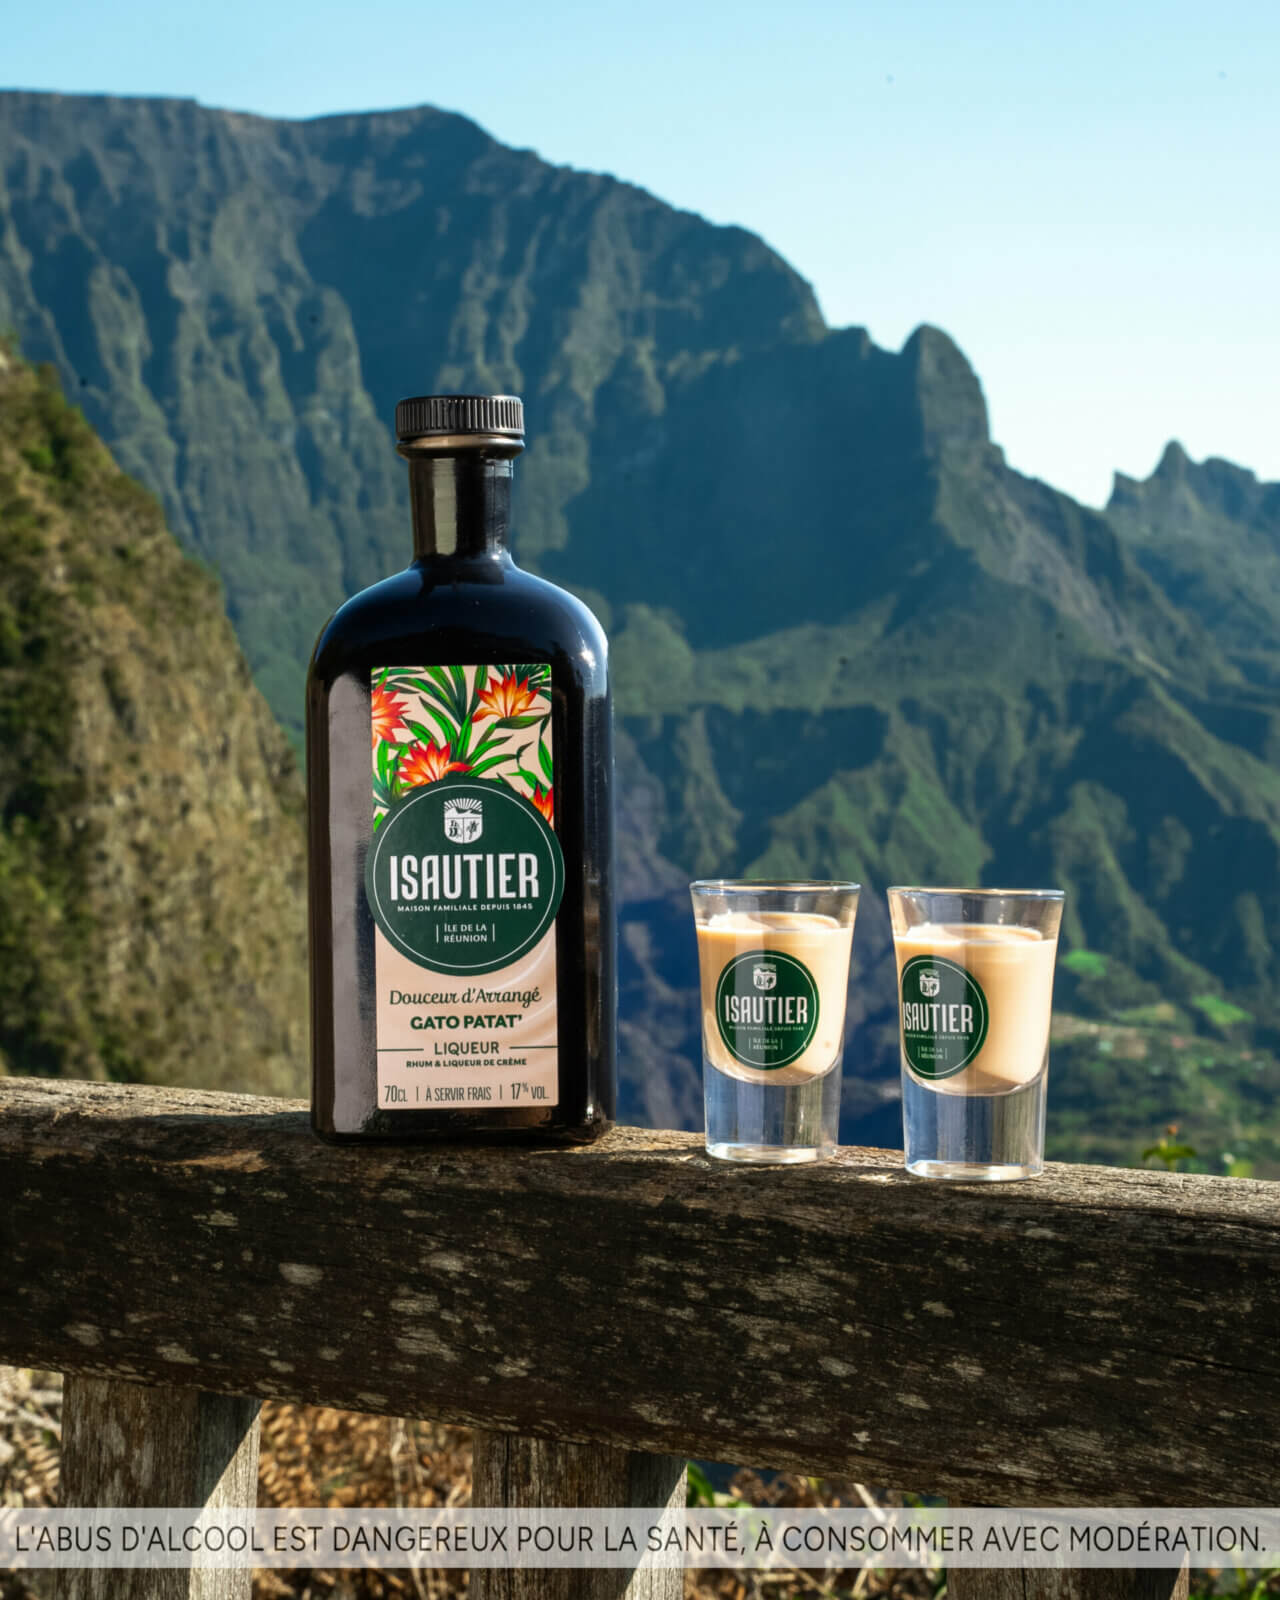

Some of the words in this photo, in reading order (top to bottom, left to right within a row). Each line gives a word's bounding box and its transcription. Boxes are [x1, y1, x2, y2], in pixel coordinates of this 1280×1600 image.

[390, 853, 539, 901] ISAUTIER
[397, 904, 431, 912] MAISON
[433, 903, 477, 912] FAMILIALE
[480, 903, 510, 911] DEPUIS
[513, 902, 533, 910] 1845
[460, 924, 473, 932] DE
[475, 923, 487, 931] LA
[443, 934, 488, 943] RÉUNION
[389, 990, 460, 1005] Douceur
[461, 987, 542, 1009] d'Arrangé
[725, 995, 808, 1024] ISAUTIER
[903, 1001, 973, 1033] ISAUTIER
[410, 1015, 460, 1030] GATO
[463, 1014, 523, 1028] PATAT'
[434, 1041, 500, 1057] LIQUEUR
[406, 1060, 433, 1068] RHUM
[443, 1059, 481, 1068] LIQUEUR
[434, 1087, 465, 1102] SERVIR
[467, 1086, 492, 1101] FRAIS
